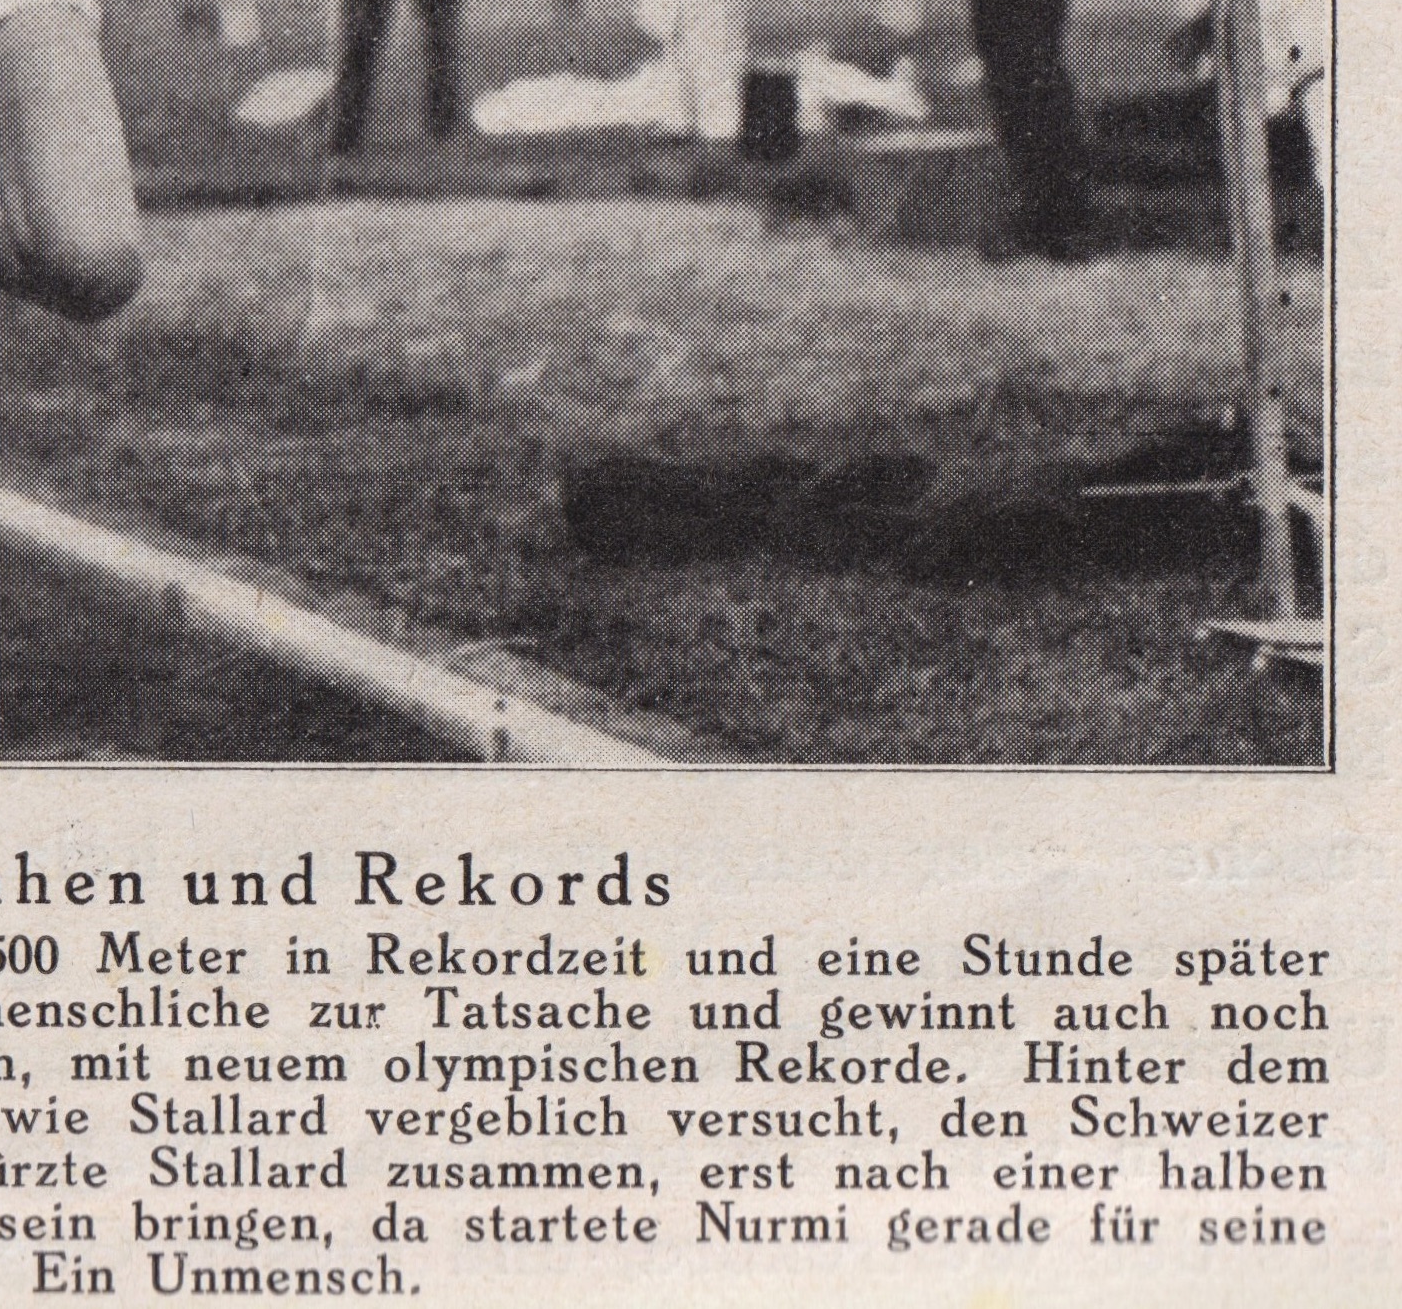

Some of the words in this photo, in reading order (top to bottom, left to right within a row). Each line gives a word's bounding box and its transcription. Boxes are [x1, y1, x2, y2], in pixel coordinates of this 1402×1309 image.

[183, 851, 317, 906] und
[354, 851, 670, 907] Rekords
[96, 931, 247, 975] Meter
[286, 935, 331, 975] in
[366, 931, 647, 977] Rekordzeit
[686, 934, 777, 976] und
[818, 937, 920, 977] eine
[962, 933, 1132, 977] Stunde
[1175, 939, 1330, 986] später
[309, 1002, 386, 1029] zur
[424, 986, 651, 1030] Tatsache
[689, 988, 781, 1030] und
[820, 991, 1015, 1039] gewinnt
[1054, 988, 1169, 1031] auch
[1211, 989, 1329, 1031] noch
[71, 1043, 150, 1081] mit
[185, 1054, 347, 1082] neuem
[384, 1040, 699, 1092] olympischen
[735, 1040, 966, 1085] Rekorde.
[1024, 1040, 1186, 1084] Hinter
[1227, 1043, 1329, 1085] dem
[1, 1096, 88, 1135] wie
[130, 1092, 327, 1136] Stallard
[365, 1094, 627, 1144] vergeblich
[667, 1095, 898, 1144] versucht,
[940, 1096, 1027, 1138] den
[1071, 1094, 1328, 1138] Schweizer
[150, 1145, 347, 1189] Stallard
[387, 1162, 659, 1196] zusammen,
[700, 1154, 794, 1189] erst
[836, 1149, 948, 1189] nach
[993, 1152, 1119, 1189] einer
[1159, 1149, 1325, 1190] halben
[132, 1200, 332, 1249] bringen,
[372, 1201, 426, 1242] da
[466, 1205, 656, 1243] startete
[697, 1201, 846, 1242] Nurmi
[889, 1203, 1049, 1249] gerade
[1093, 1203, 1156, 1242] für
[1200, 1207, 1324, 1242] seine
[33, 1251, 114, 1293] Ein
[149, 1252, 419, 1295] Unmensch.
